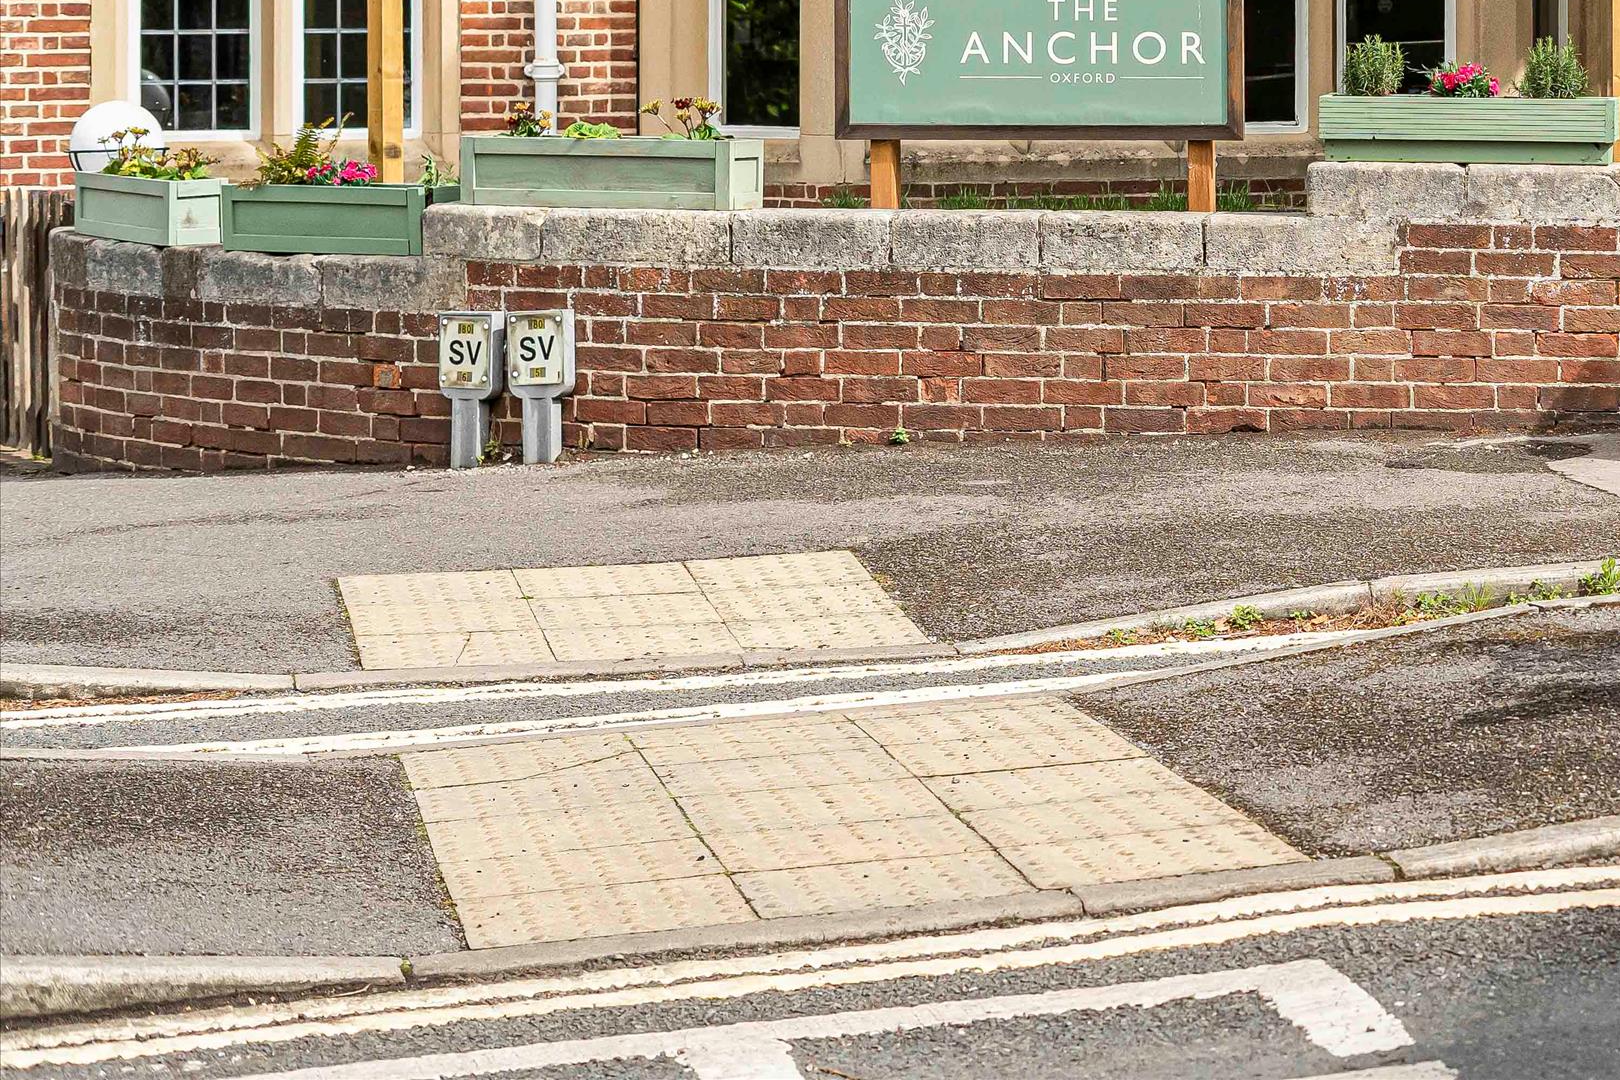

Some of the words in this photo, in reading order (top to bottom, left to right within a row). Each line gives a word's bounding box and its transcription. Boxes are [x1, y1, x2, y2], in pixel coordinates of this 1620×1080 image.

[959, 30, 1206, 65] ANCHOR
[1049, 73, 1116, 84] OXFORD
[448, 340, 482, 366] SV
[519, 335, 555, 362] SV
